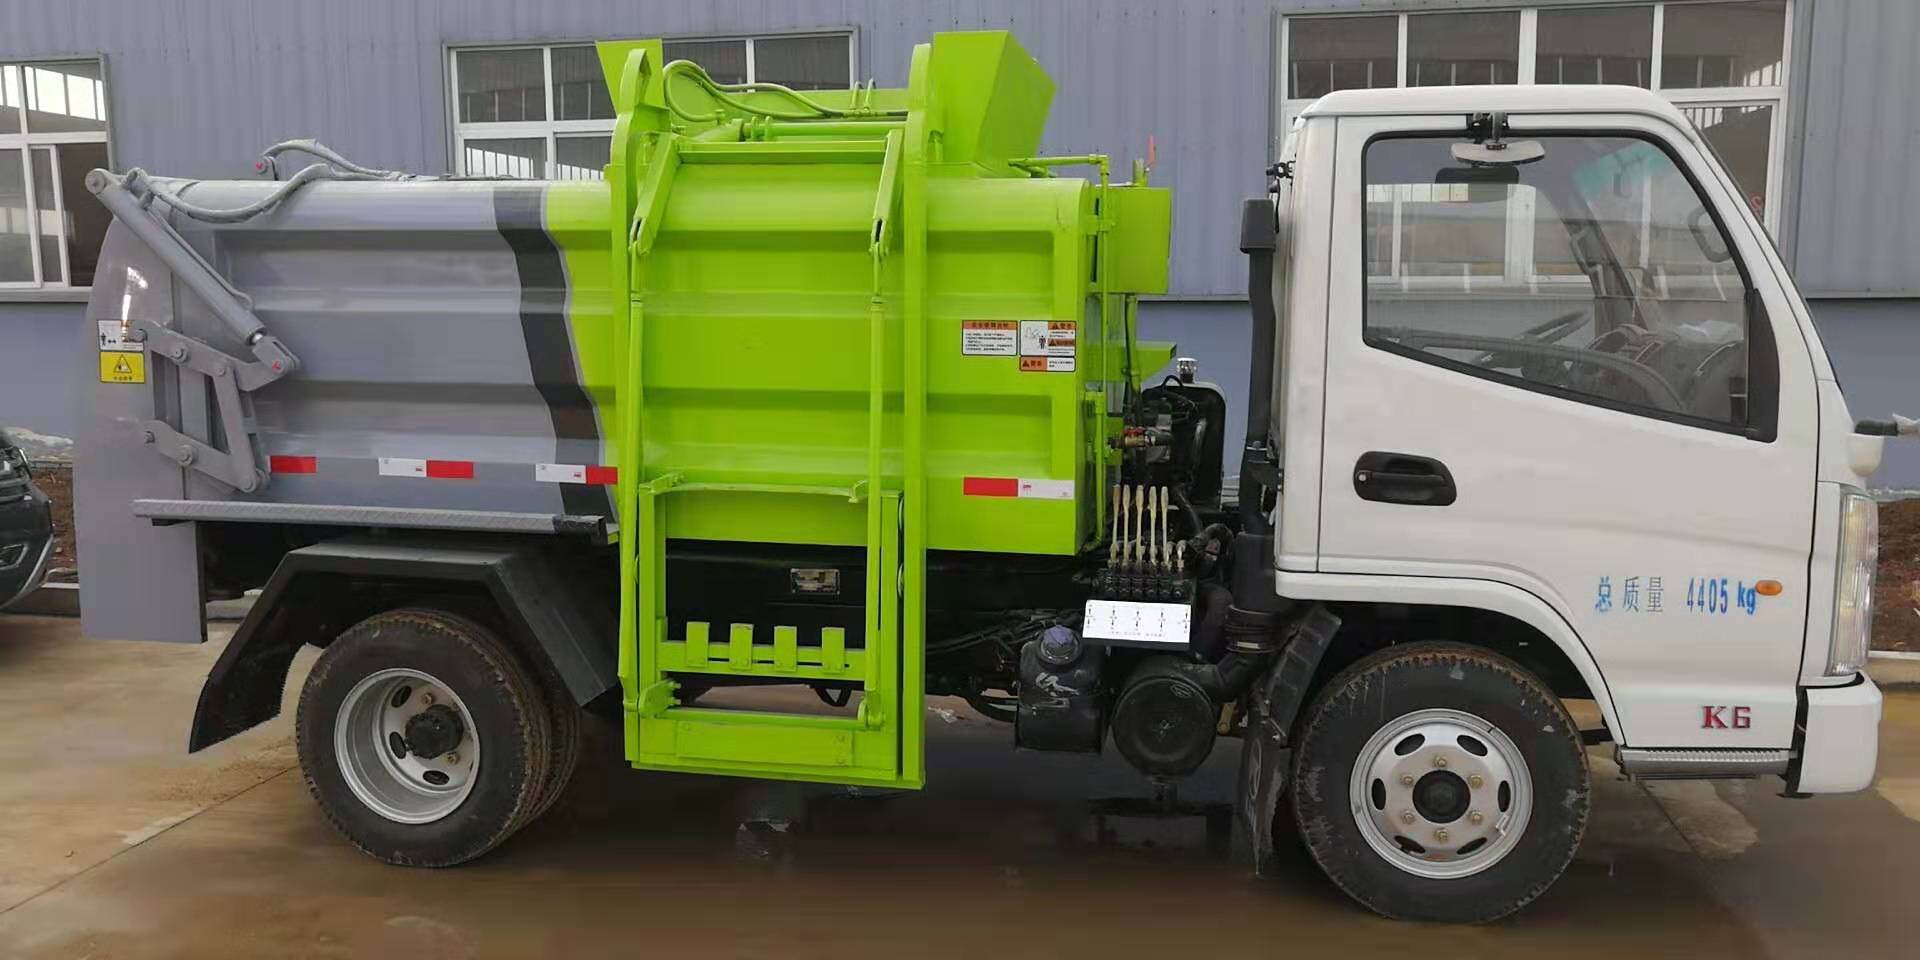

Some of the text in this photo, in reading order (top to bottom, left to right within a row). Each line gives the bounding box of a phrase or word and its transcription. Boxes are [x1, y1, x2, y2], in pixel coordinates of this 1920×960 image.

[1595, 576, 1756, 615] 总质量 4405 kg
[1701, 705, 1751, 729] K6
